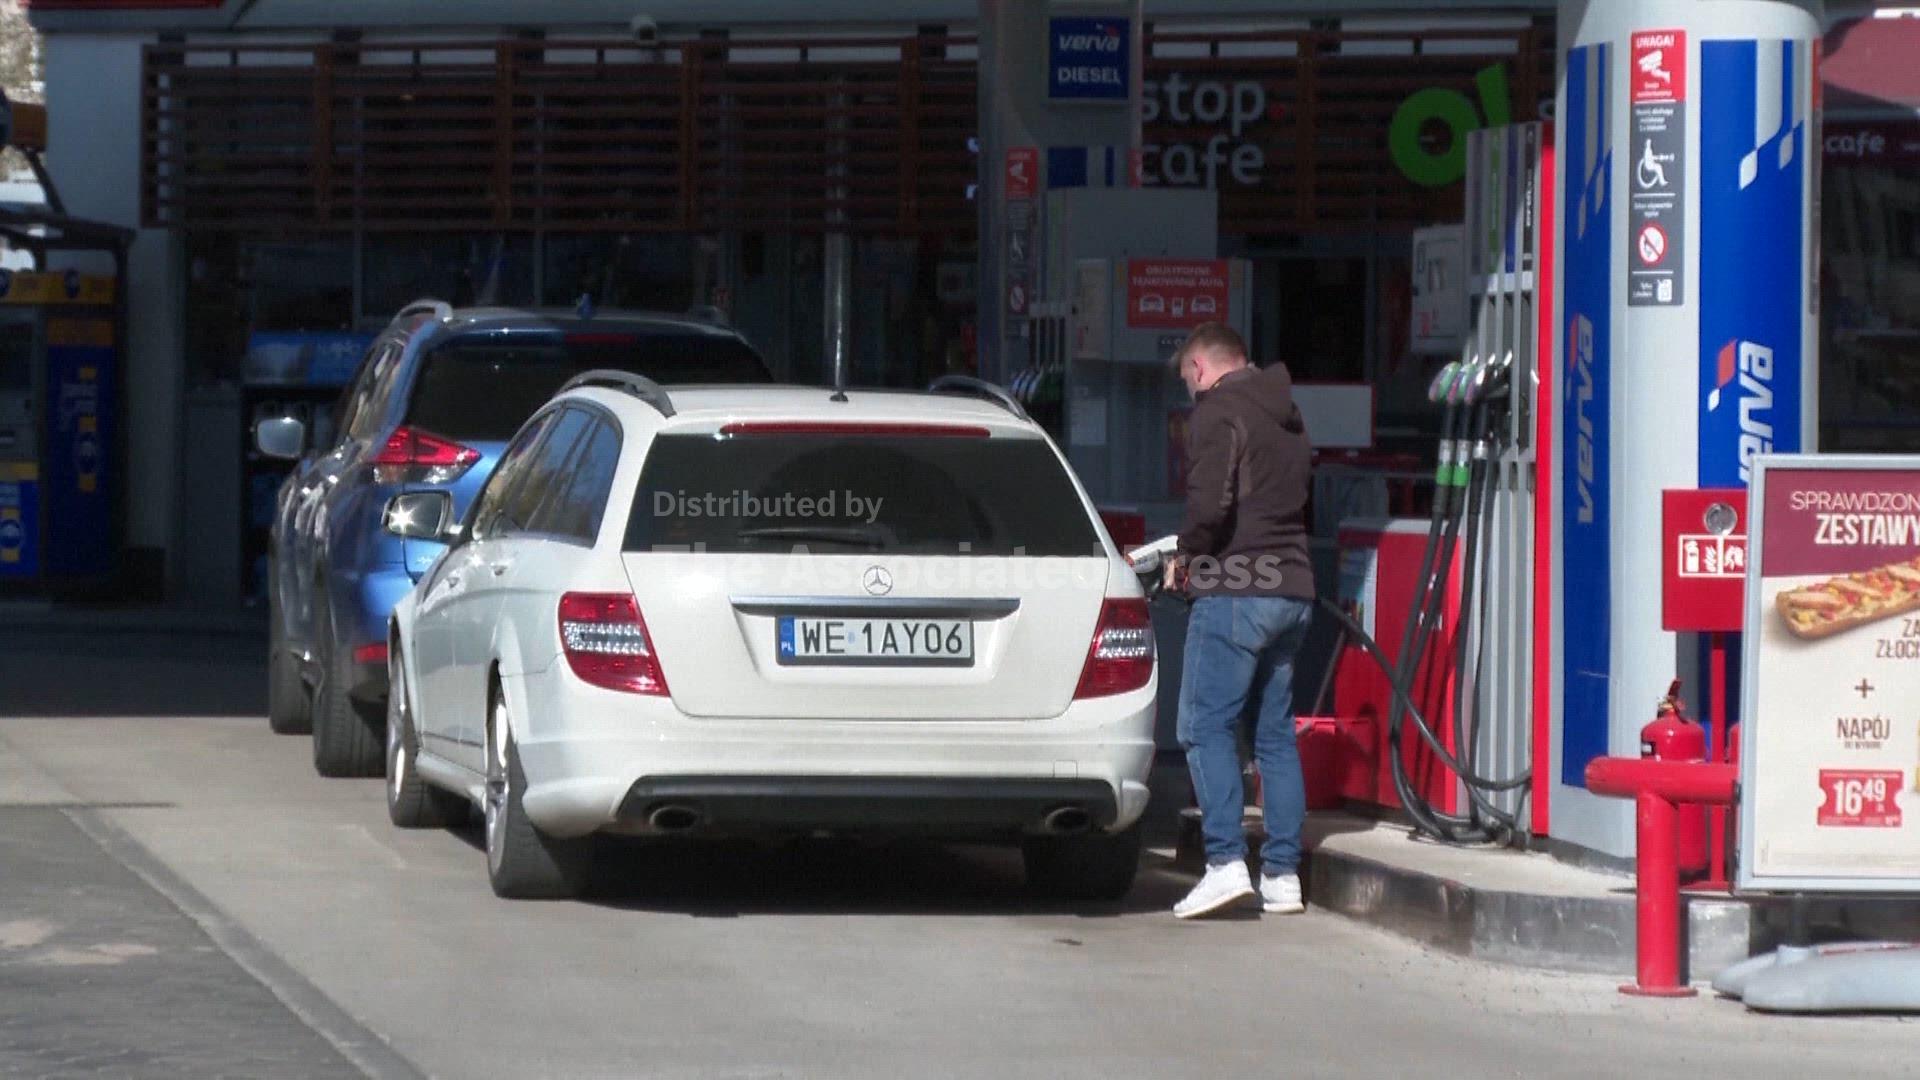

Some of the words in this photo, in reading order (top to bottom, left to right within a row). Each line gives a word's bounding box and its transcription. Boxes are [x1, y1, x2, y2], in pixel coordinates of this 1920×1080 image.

[1059, 33, 1121, 53] verva
[1635, 35, 1675, 48] UWAGA!
[1057, 66, 1122, 85] DIESEL
[1825, 131, 1886, 158] cafe
[1577, 315, 1593, 523] verva
[1739, 341, 1774, 484] erva
[1815, 514, 1920, 546] ZESTAWY
[780, 641, 793, 652] PL
[802, 621, 845, 653] WE
[861, 622, 963, 654] 1AY06
[1837, 712, 1891, 740] NAPÓJ
